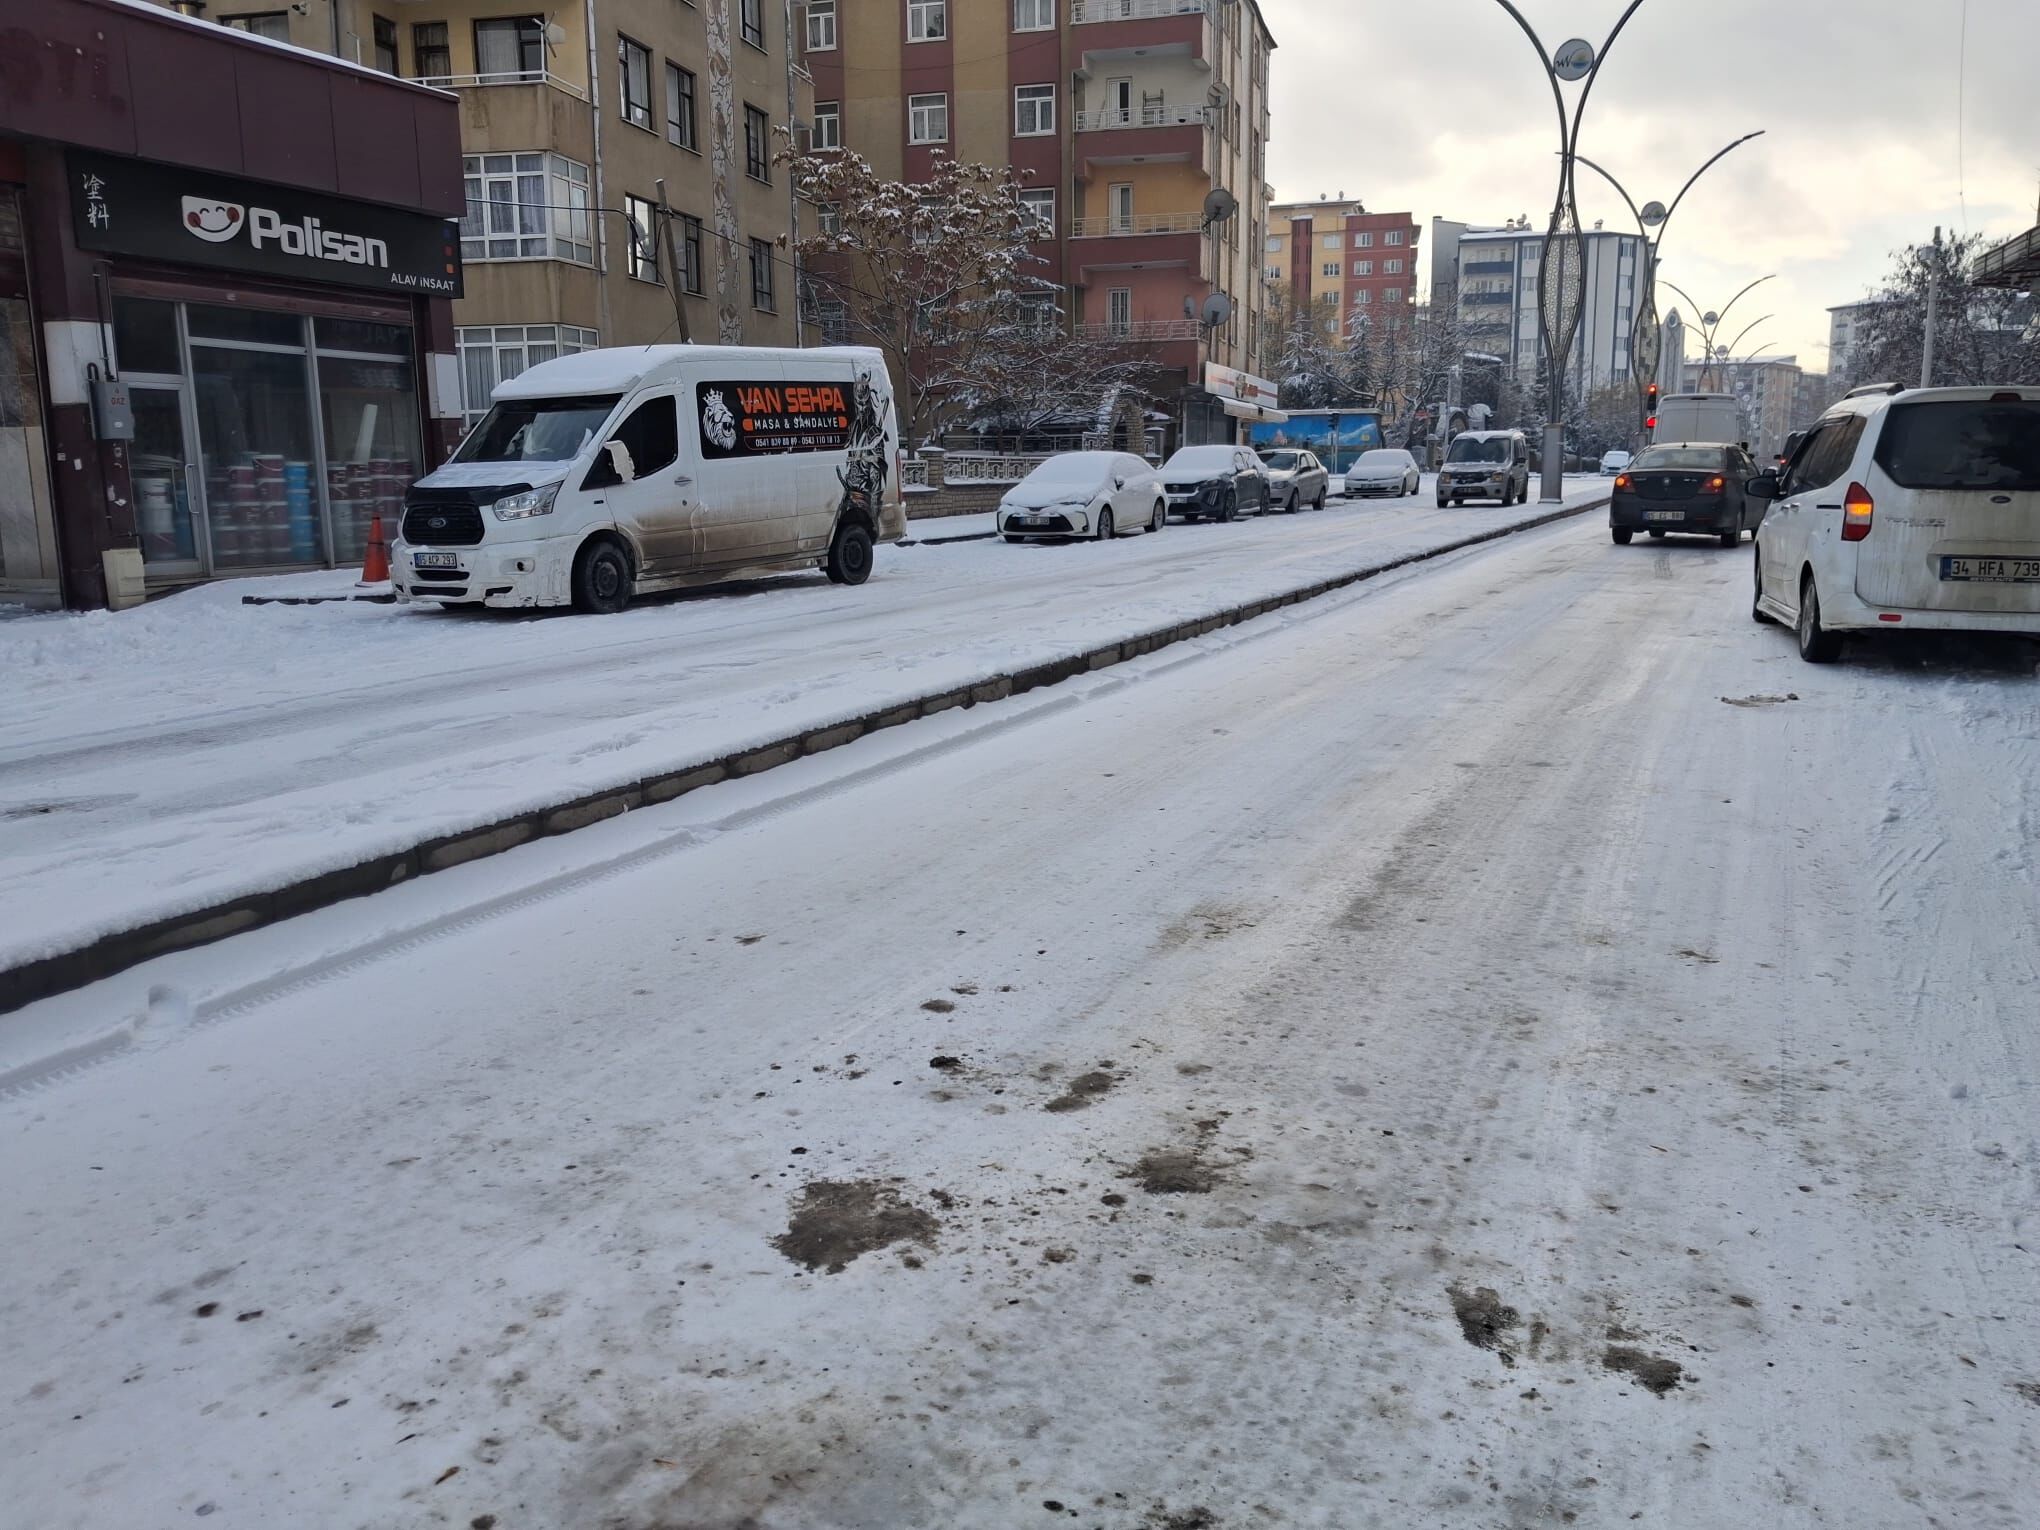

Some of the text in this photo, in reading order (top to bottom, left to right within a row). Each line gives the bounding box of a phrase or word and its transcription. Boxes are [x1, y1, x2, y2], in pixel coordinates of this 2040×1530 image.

[249, 206, 388, 268] Polisan
[390, 272, 417, 286] ALAV
[737, 387, 846, 414] VAN SEHPA
[754, 416, 838, 430] MASA & SANDALYE
[1952, 560, 2040, 577] 34 HFA 739
